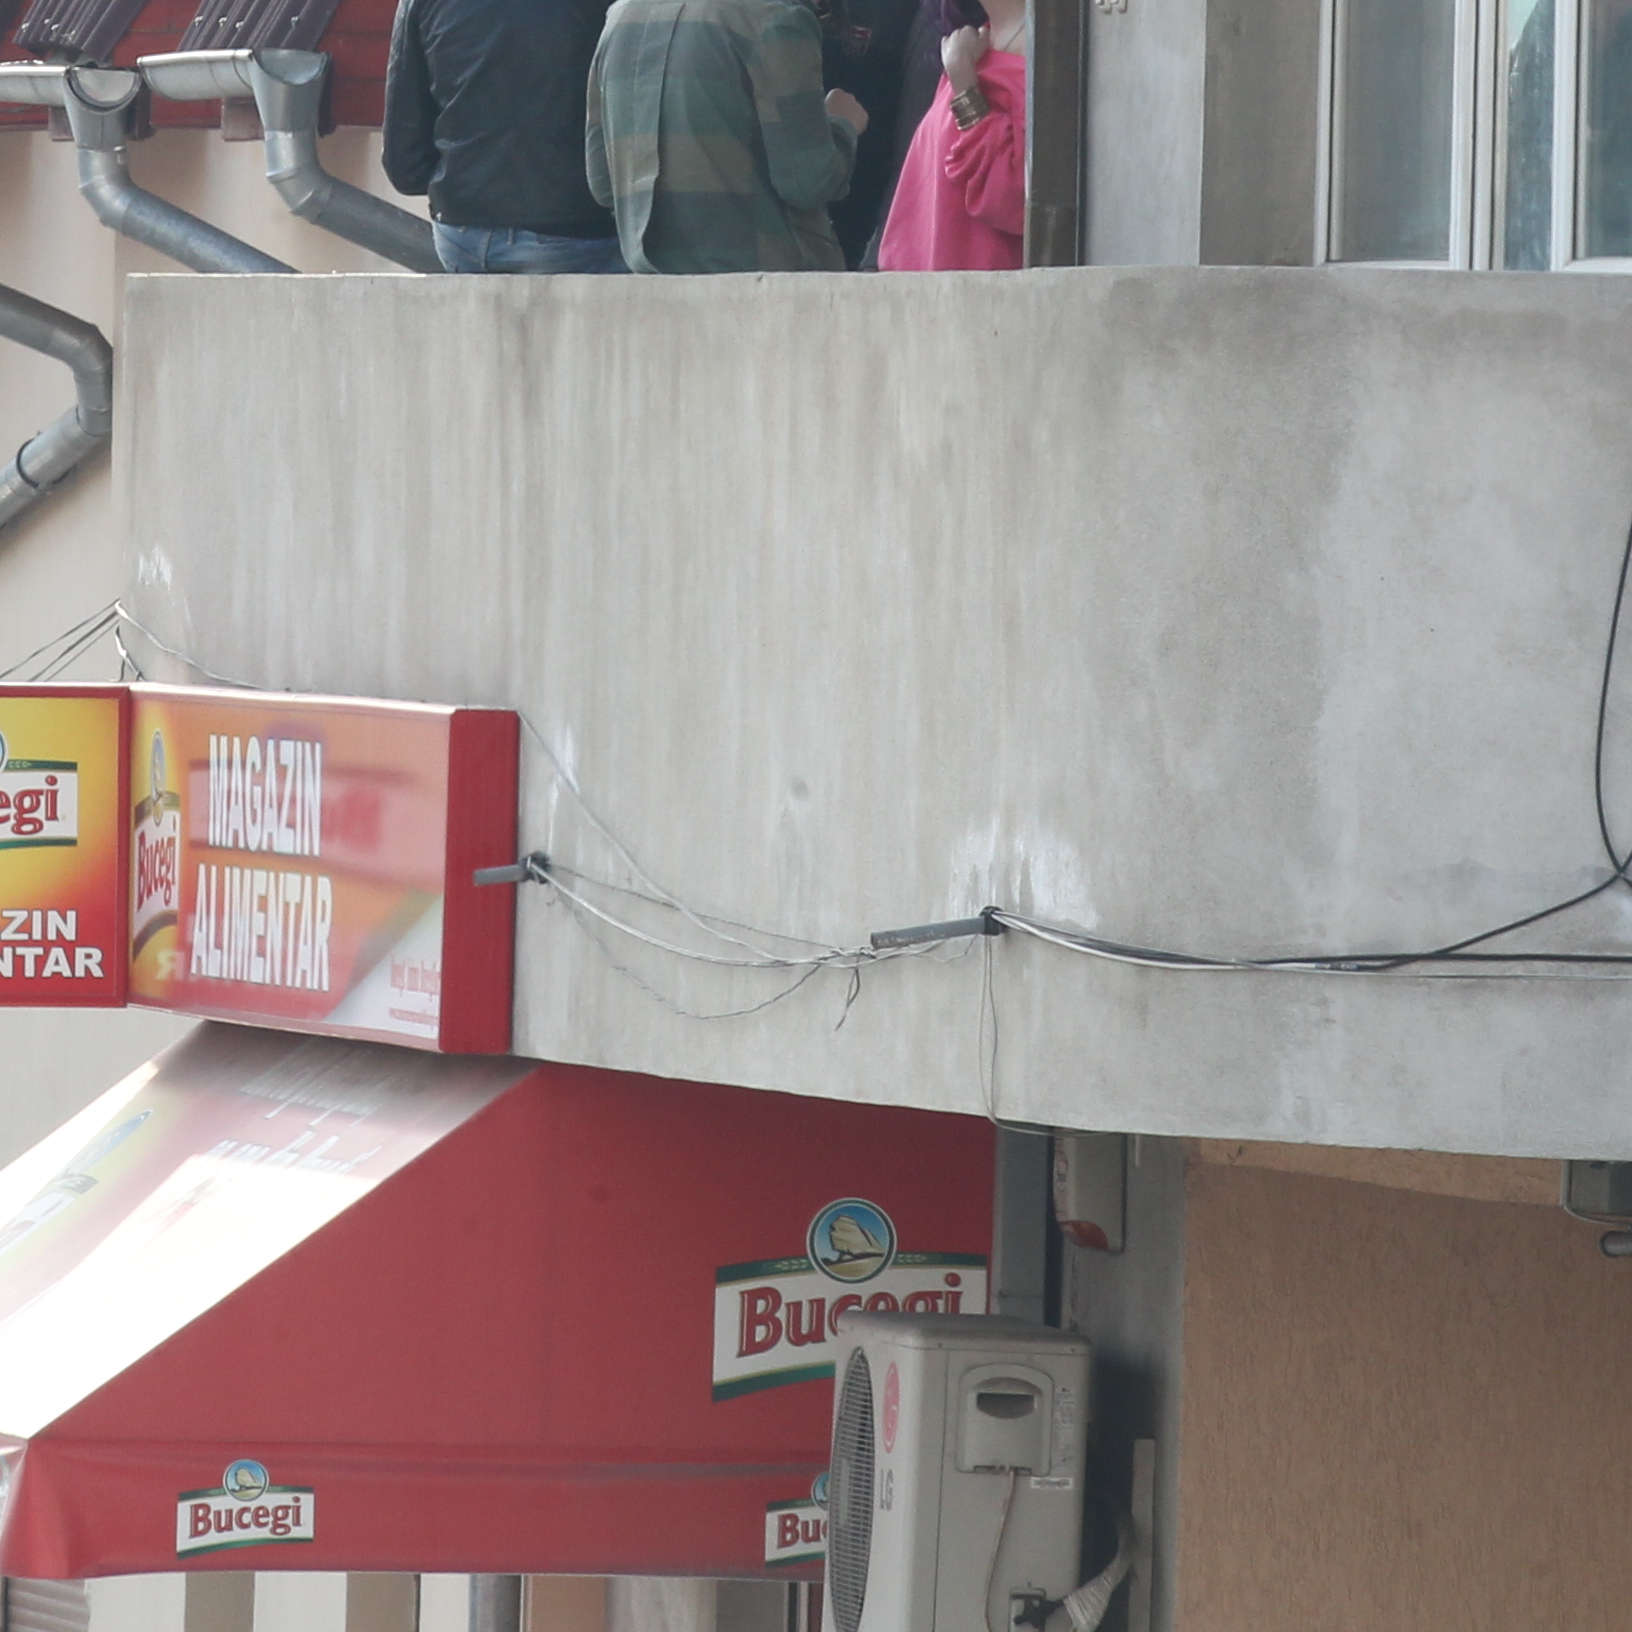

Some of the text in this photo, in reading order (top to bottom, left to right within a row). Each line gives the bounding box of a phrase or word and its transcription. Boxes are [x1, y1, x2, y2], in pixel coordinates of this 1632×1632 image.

[208, 733, 323, 858] MAGAZIN
[136, 816, 177, 914] Bucegi
[189, 862, 333, 993] ALIMENTAR
[188, 1495, 303, 1540] Bucegi
